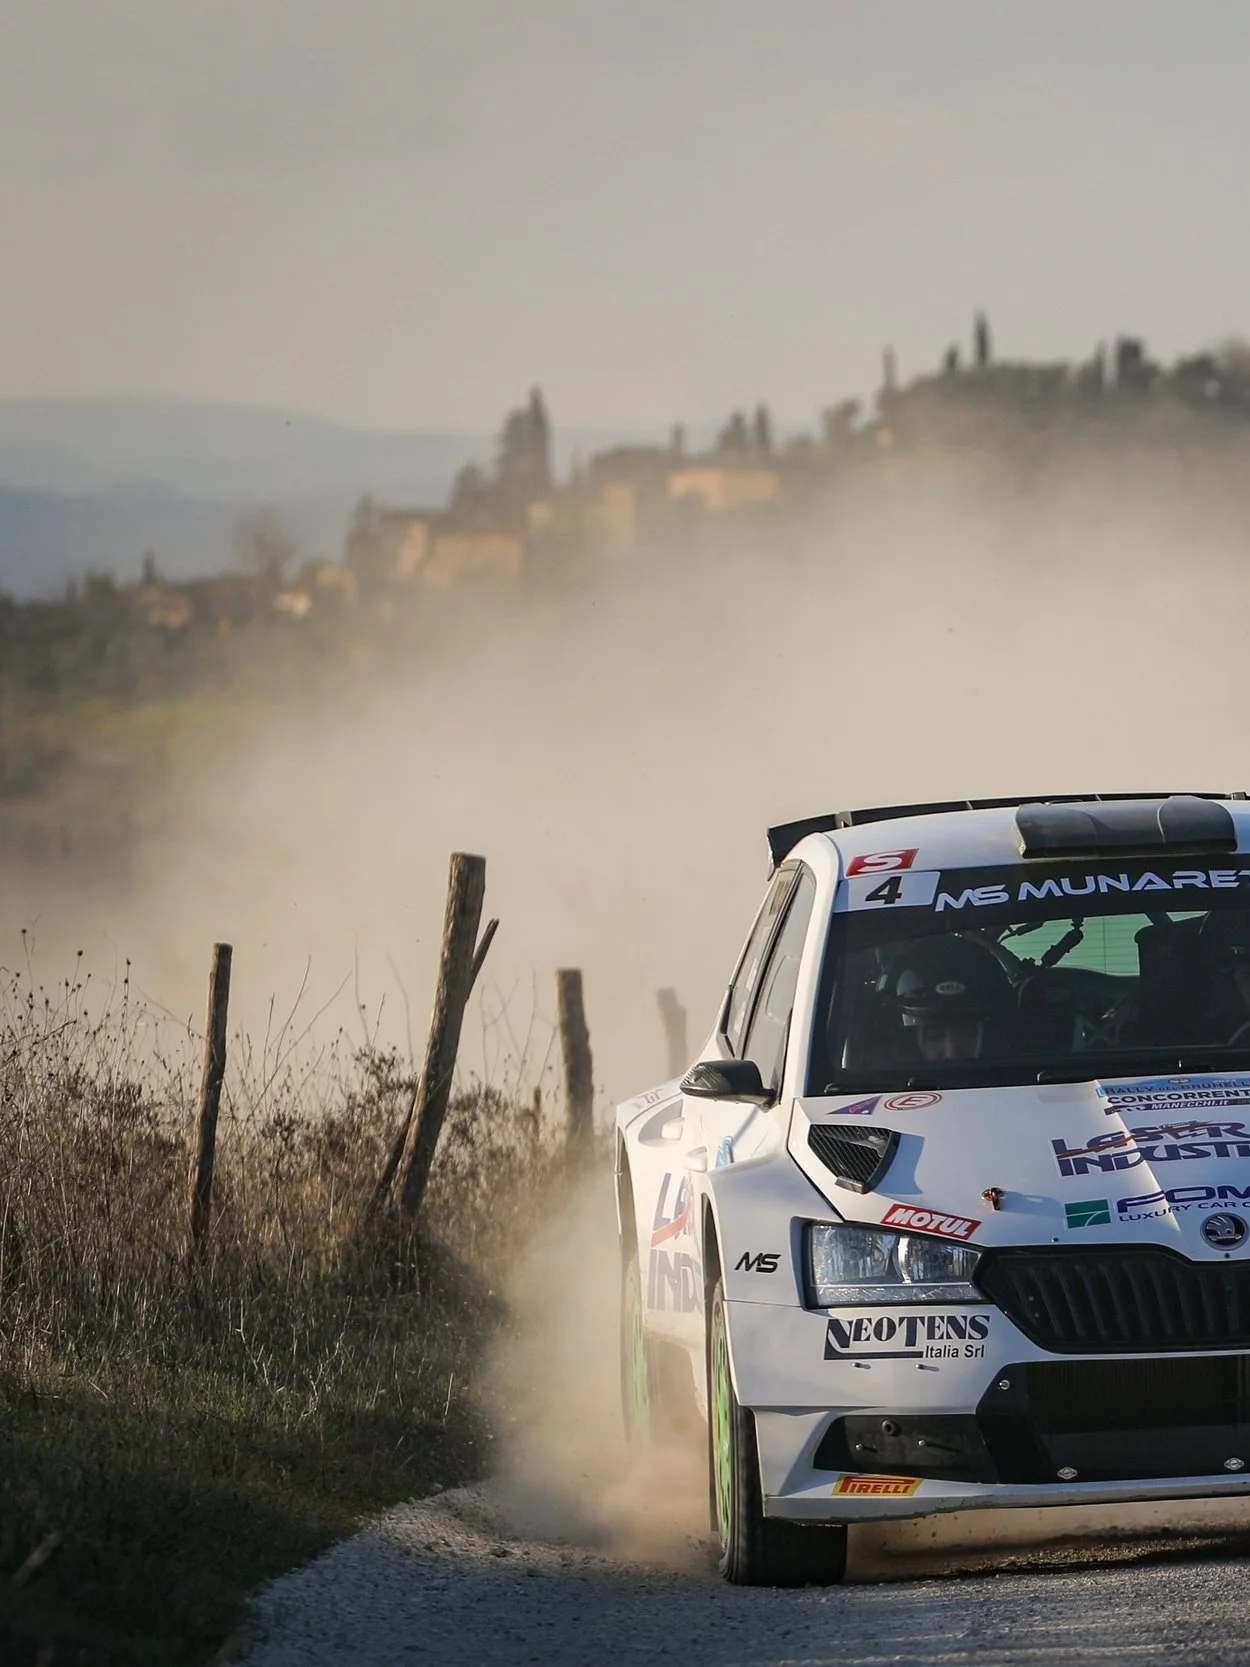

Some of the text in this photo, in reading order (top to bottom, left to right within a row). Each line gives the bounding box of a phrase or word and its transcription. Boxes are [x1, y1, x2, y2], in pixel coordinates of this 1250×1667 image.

[865, 876, 902, 904] 4
[935, 885, 1010, 911] MS
[1105, 1086, 1152, 1095] RALLY
[886, 1207, 971, 1237] MOTUL
[1119, 1204, 1191, 1222] LUXURY
[1198, 1201, 1236, 1209] CAR
[734, 1251, 781, 1273] MS
[825, 1315, 990, 1354] NEOTENS
[925, 1344, 984, 1358] Italia Srl
[839, 1476, 916, 1493] PIRELLI
